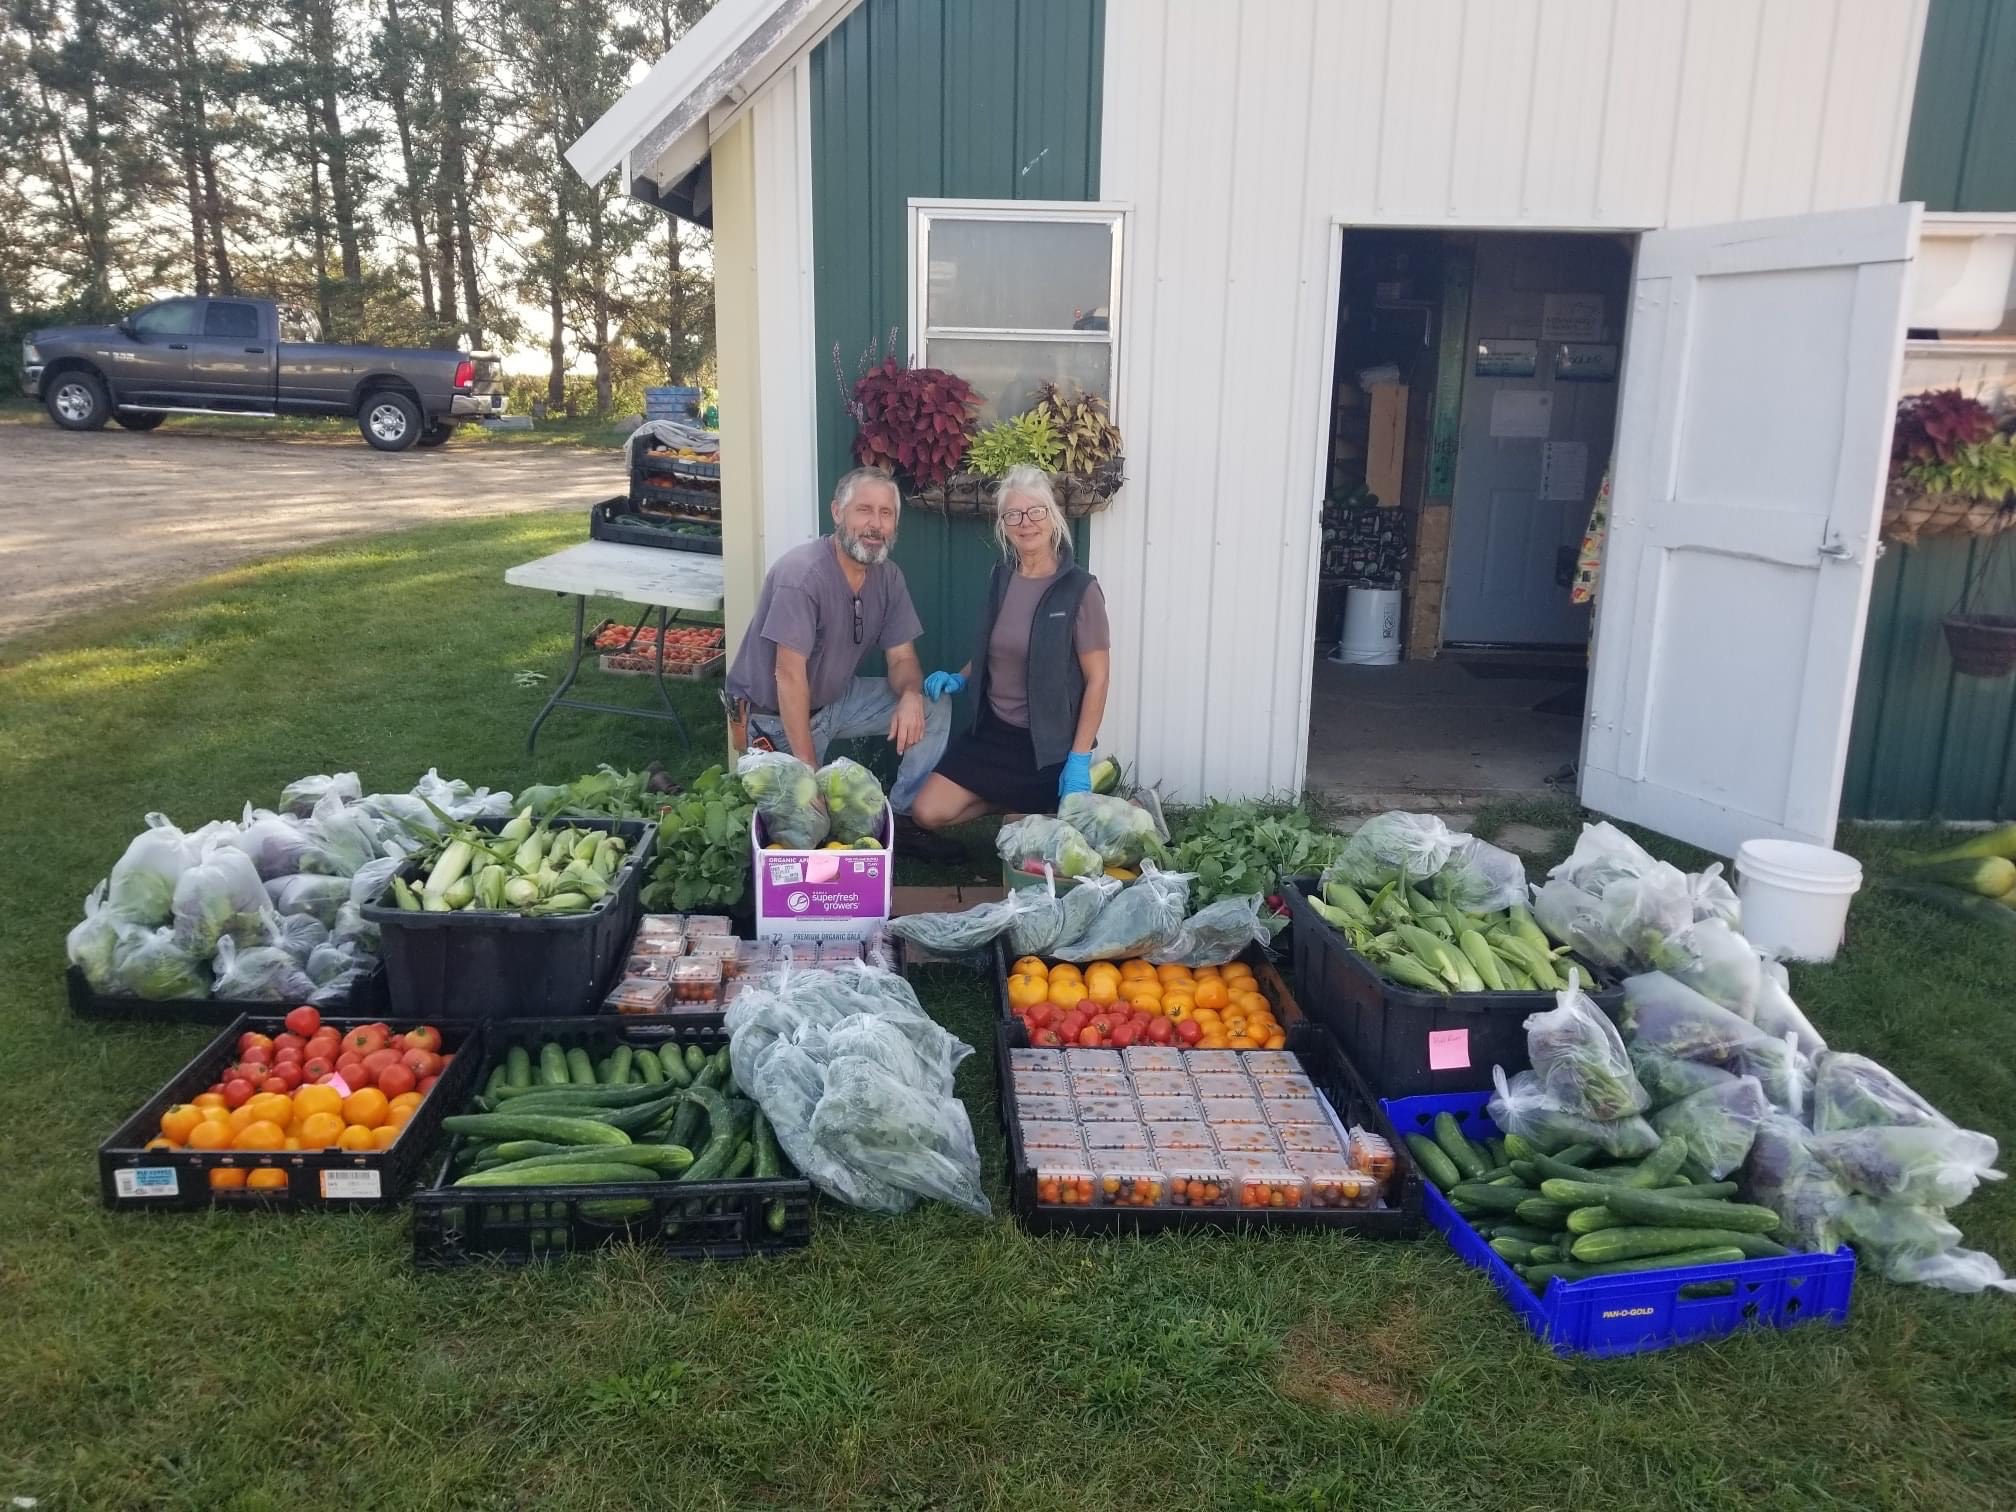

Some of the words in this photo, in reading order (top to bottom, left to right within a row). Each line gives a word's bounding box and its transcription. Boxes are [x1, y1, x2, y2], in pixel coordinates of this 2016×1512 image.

[811, 892, 859, 903] superfresh
[823, 903, 859, 911] growers
[793, 933, 820, 941] PREMIUM
[821, 933, 846, 941] ORGANIC
[1602, 1307, 1654, 1319] PAN-O-GOLD
